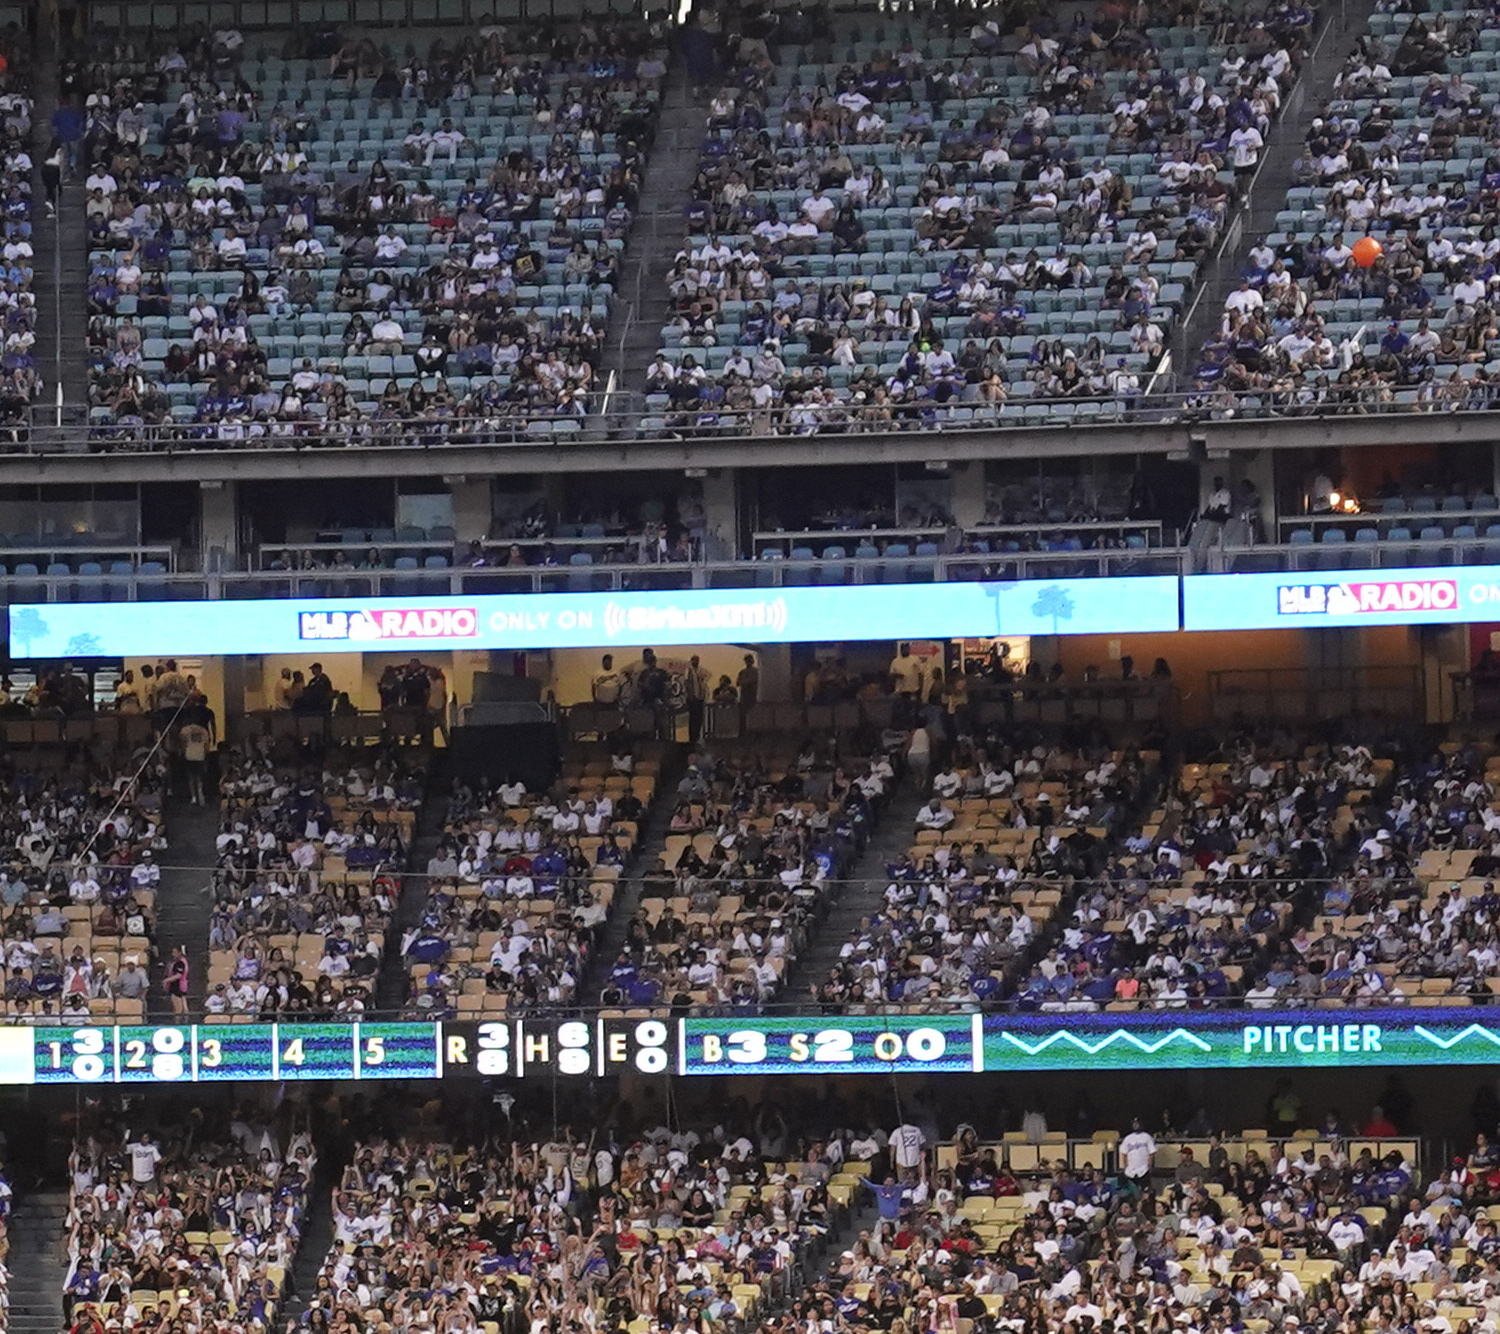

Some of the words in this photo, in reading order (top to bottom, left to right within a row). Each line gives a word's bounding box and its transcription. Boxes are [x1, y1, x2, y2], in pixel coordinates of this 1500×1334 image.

[1280, 586, 1326, 606] MLB
[1360, 581, 1456, 609] RADIO
[302, 612, 348, 632] MLB
[383, 609, 476, 637] RADIO
[489, 611, 549, 632] ONLY
[557, 610, 594, 630] ON
[49, 1041, 62, 1069] 1
[125, 1040, 146, 1068] 2
[202, 1038, 222, 1067] 3
[283, 1038, 305, 1064] 4
[365, 1036, 385, 1065] 5
[447, 1035, 468, 1063] R
[526, 1035, 549, 1062] H
[609, 1034, 627, 1062] E
[72, 1028, 104, 1054] 3
[152, 1027, 185, 1053] 0
[477, 1022, 509, 1049] 3
[635, 1021, 668, 1046] 0
[1243, 1025, 1382, 1053] PITCHER
[72, 1054, 104, 1080] 0
[635, 1046, 668, 1073] 0
